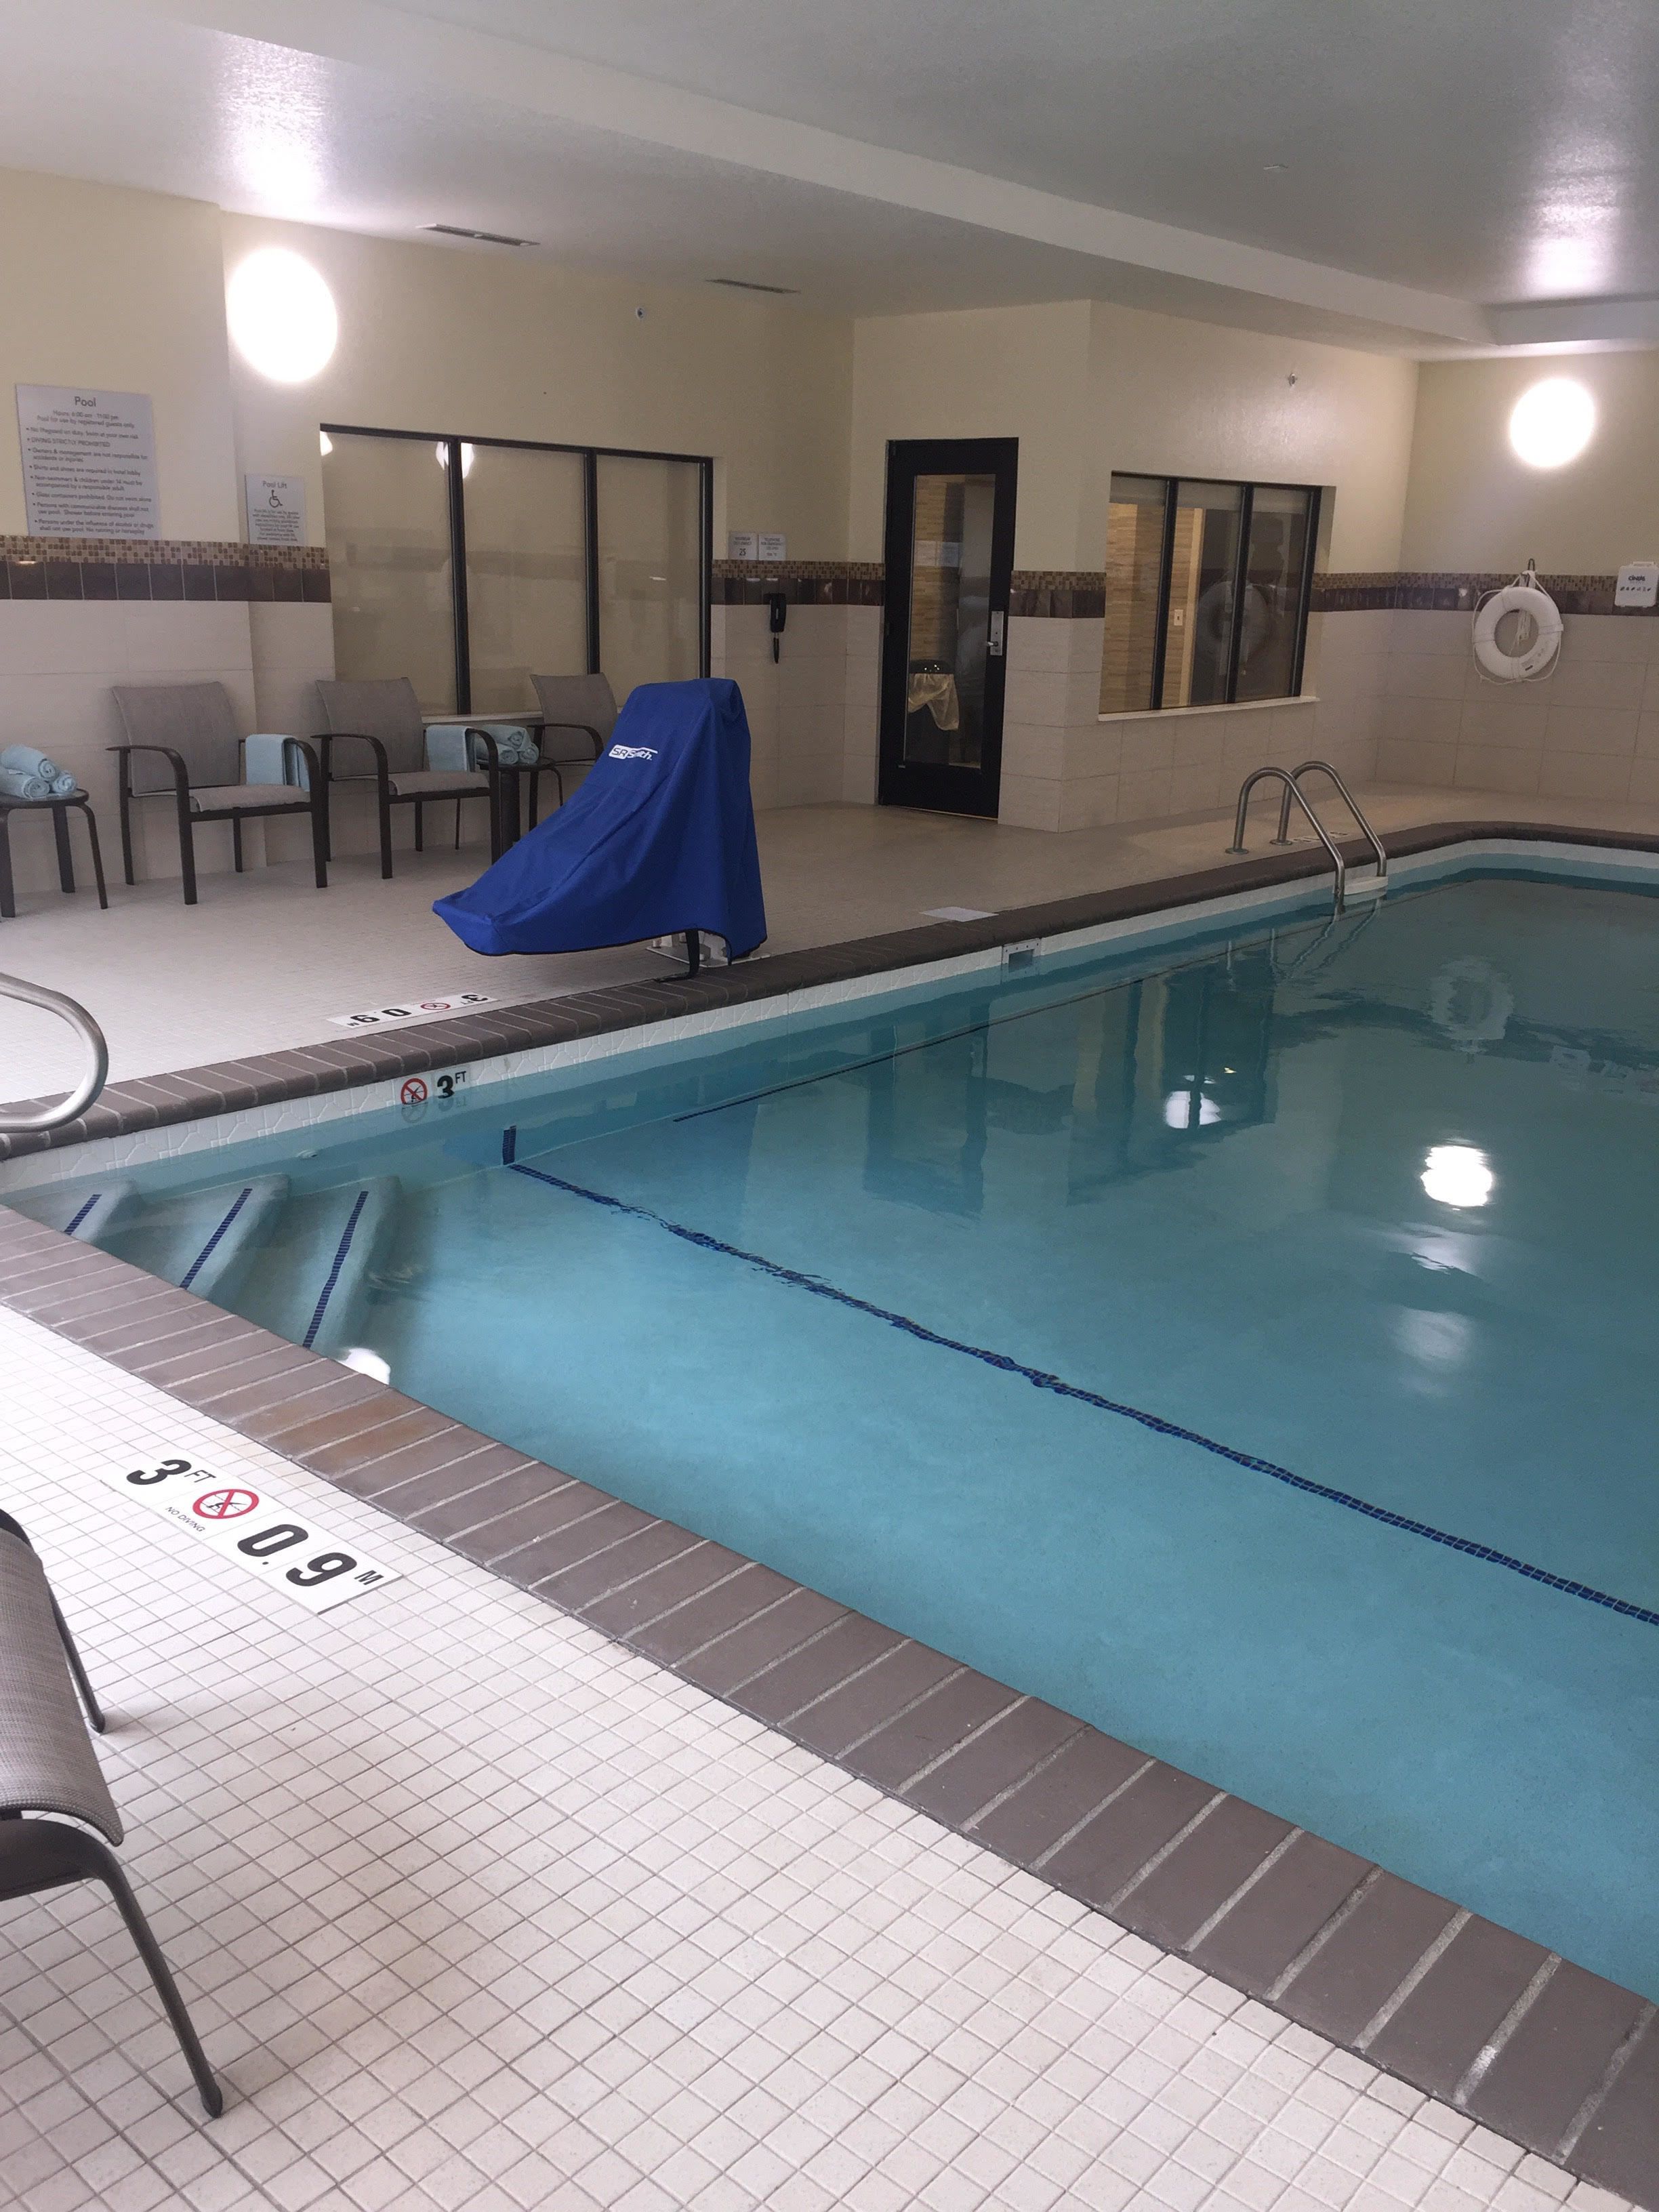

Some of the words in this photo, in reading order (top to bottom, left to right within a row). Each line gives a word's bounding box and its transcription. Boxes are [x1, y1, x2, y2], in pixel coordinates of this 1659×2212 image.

[74, 396, 97, 407] Pool
[262, 480, 276, 488] Pool
[461, 994, 489, 1002] 3
[436, 1075, 455, 1099] 3
[455, 1071, 467, 1084] FT
[125, 1459, 192, 1486] 3
[184, 1469, 218, 1483] FT
[165, 1507, 180, 1515] NO
[178, 1514, 206, 1532] DIVING
[354, 1570, 385, 1586] M
